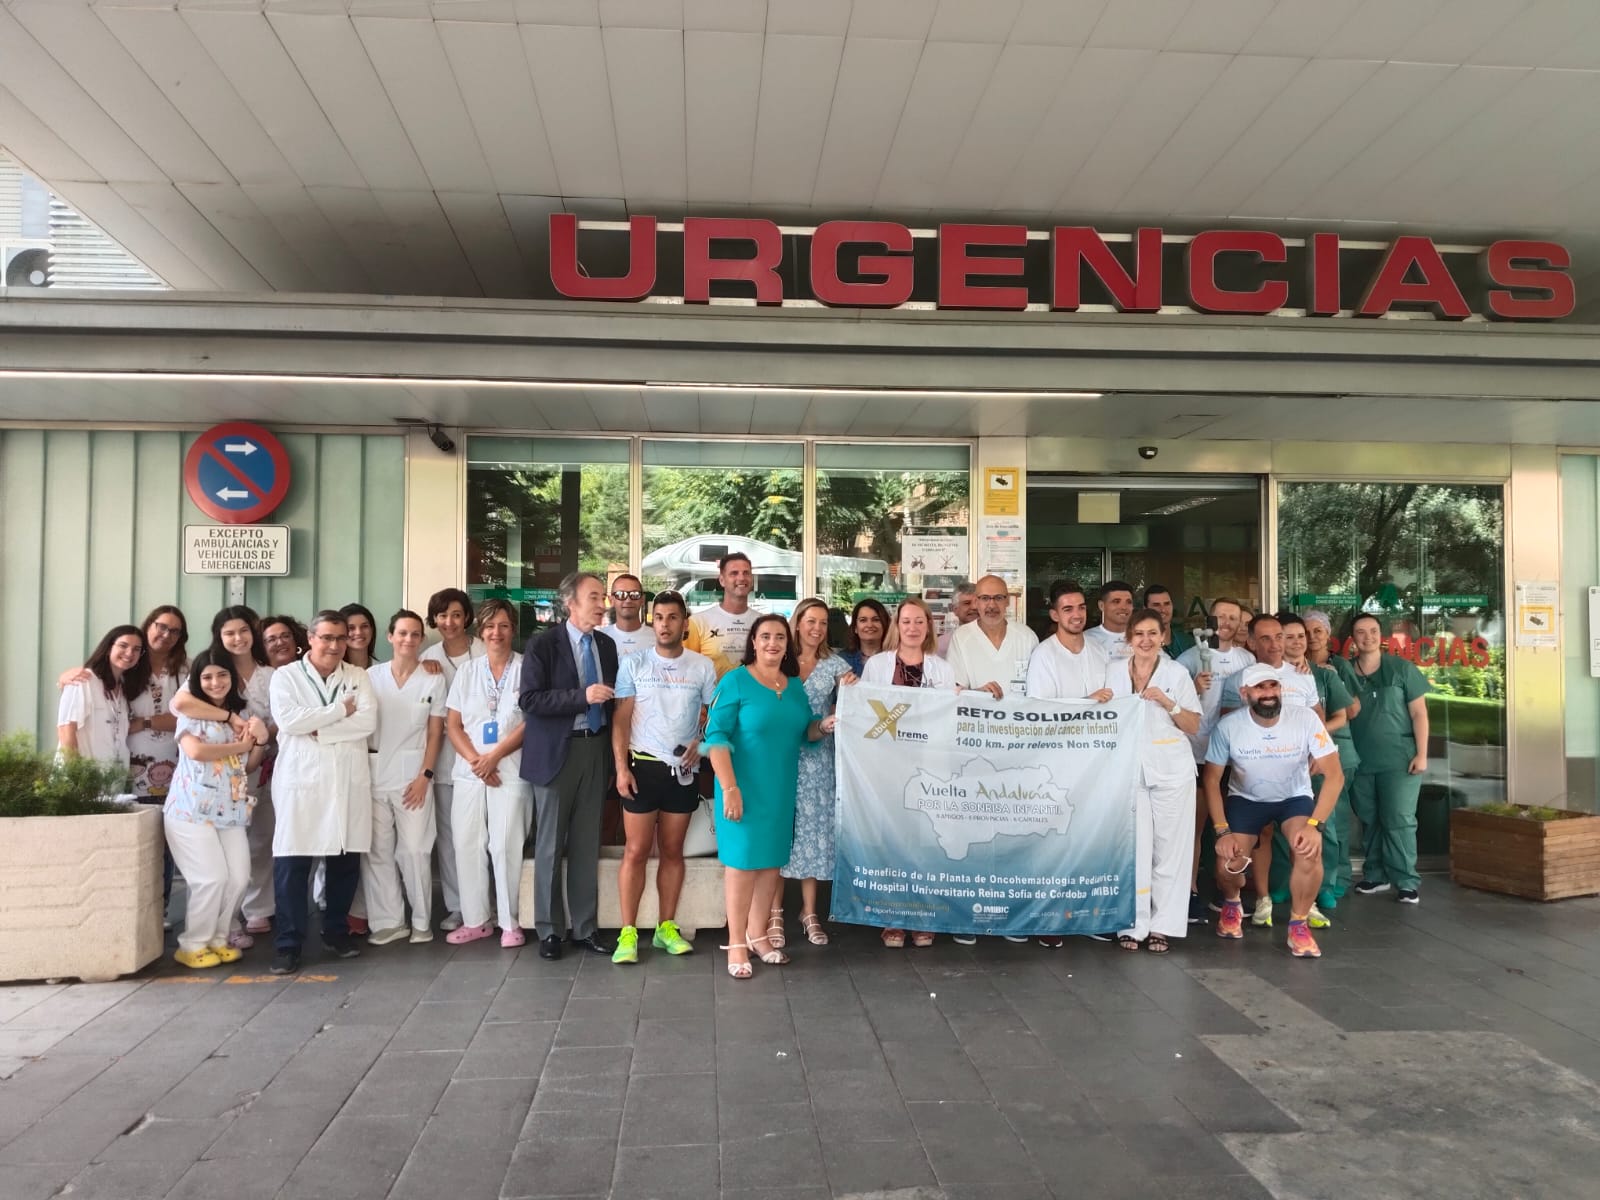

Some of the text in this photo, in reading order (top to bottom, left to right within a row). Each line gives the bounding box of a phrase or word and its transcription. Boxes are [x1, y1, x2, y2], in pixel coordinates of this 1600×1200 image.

[549, 213, 1576, 321] URGENCIAS
[209, 529, 264, 538] EXCEPTO
[193, 538, 279, 548] AMBULANCIAS Y
[261, 550, 276, 559] DE
[201, 560, 271, 570] EMERGENCIAS
[871, 704, 907, 738] abuchite
[957, 706, 1118, 722] RETO SOLIDARIO
[957, 722, 975, 734] para
[977, 720, 985, 733] la
[1045, 725, 1057, 736] del
[1086, 722, 1118, 735] infantil
[956, 737, 1117, 751] 1400 km. por relevos Non Stop
[920, 782, 967, 798] Vuelta
[918, 798, 1064, 816] POR LA SONRISA INFANTIL
[854, 865, 860, 873] a
[862, 866, 907, 878] beneficio
[910, 871, 923, 880] de
[926, 872, 936, 882] la
[939, 873, 971, 883] Planta
[974, 874, 986, 884] de
[853, 877, 867, 888] del
[869, 881, 909, 893] Hospital
[911, 884, 976, 898] Universitario
[978, 888, 1005, 898] Reina
[1035, 890, 1047, 899] de
[983, 905, 1009, 914] IMIBIC
